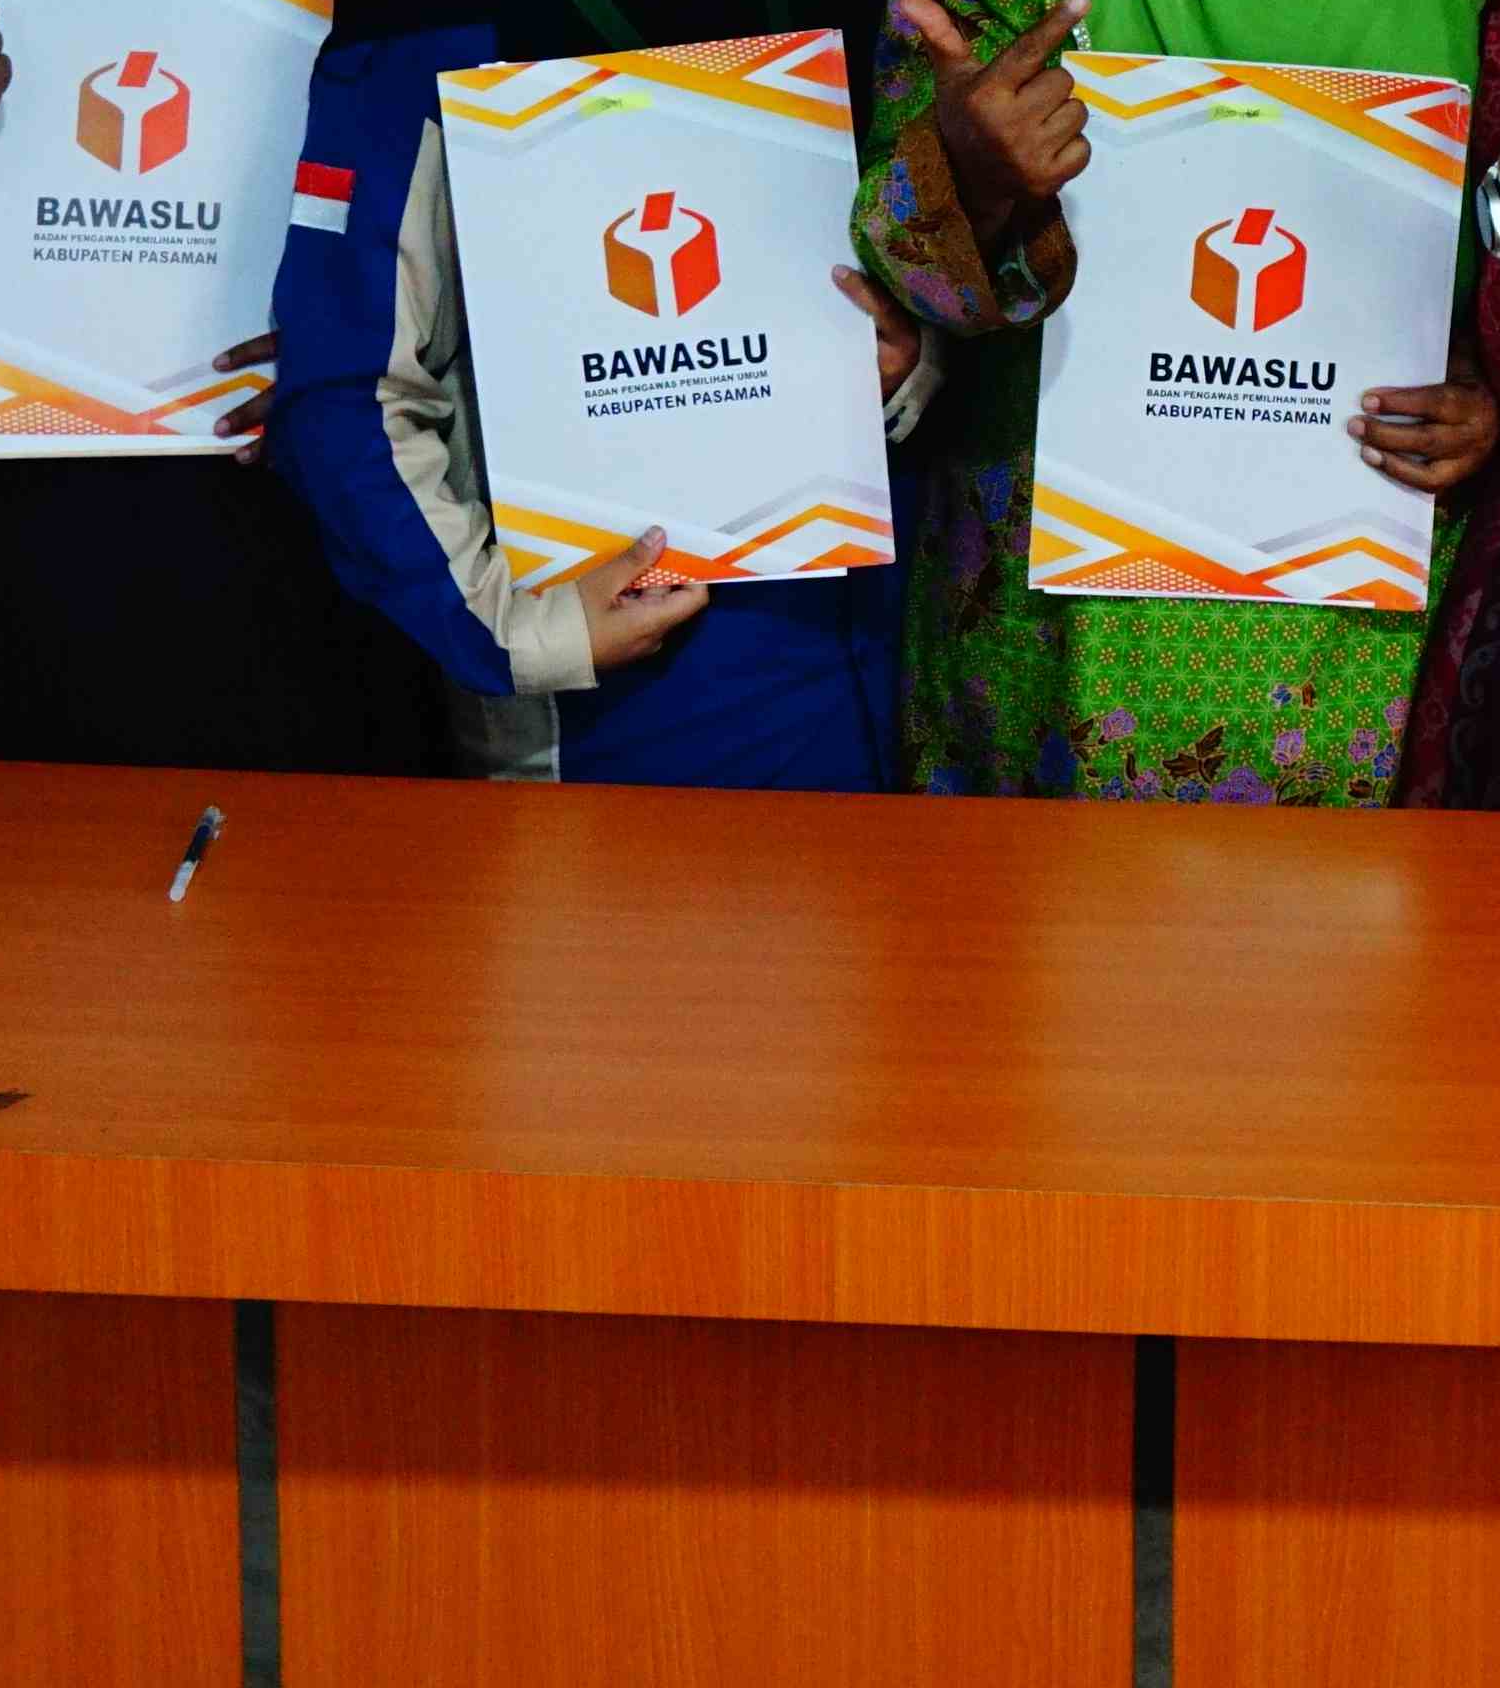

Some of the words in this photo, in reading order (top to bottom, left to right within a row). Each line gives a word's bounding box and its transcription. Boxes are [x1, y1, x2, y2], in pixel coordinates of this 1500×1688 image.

[36, 196, 221, 231] BAWASLU
[33, 233, 67, 242] BADAN
[71, 234, 125, 243] PENGAWAS
[33, 248, 133, 262] KABUPATEN
[139, 250, 217, 264] PASAMAN
[581, 333, 768, 383] BAWASLU
[1149, 352, 1336, 391] BAWASLU
[585, 388, 618, 398] BADAN
[621, 381, 677, 394] PENGAWAS
[680, 375, 734, 387] PEMILIHAN
[737, 370, 768, 380] UMUM
[1146, 389, 1180, 398] BADAN
[1183, 391, 1239, 401] PENGAWAS
[1242, 394, 1297, 404] PEMILIHAN
[1300, 397, 1331, 405] UMUM
[587, 394, 687, 418] KABUPATEN
[692, 384, 772, 406] PASAMAN
[1146, 403, 1245, 421] KABUPATEN
[1252, 408, 1331, 425] PASAMAN
